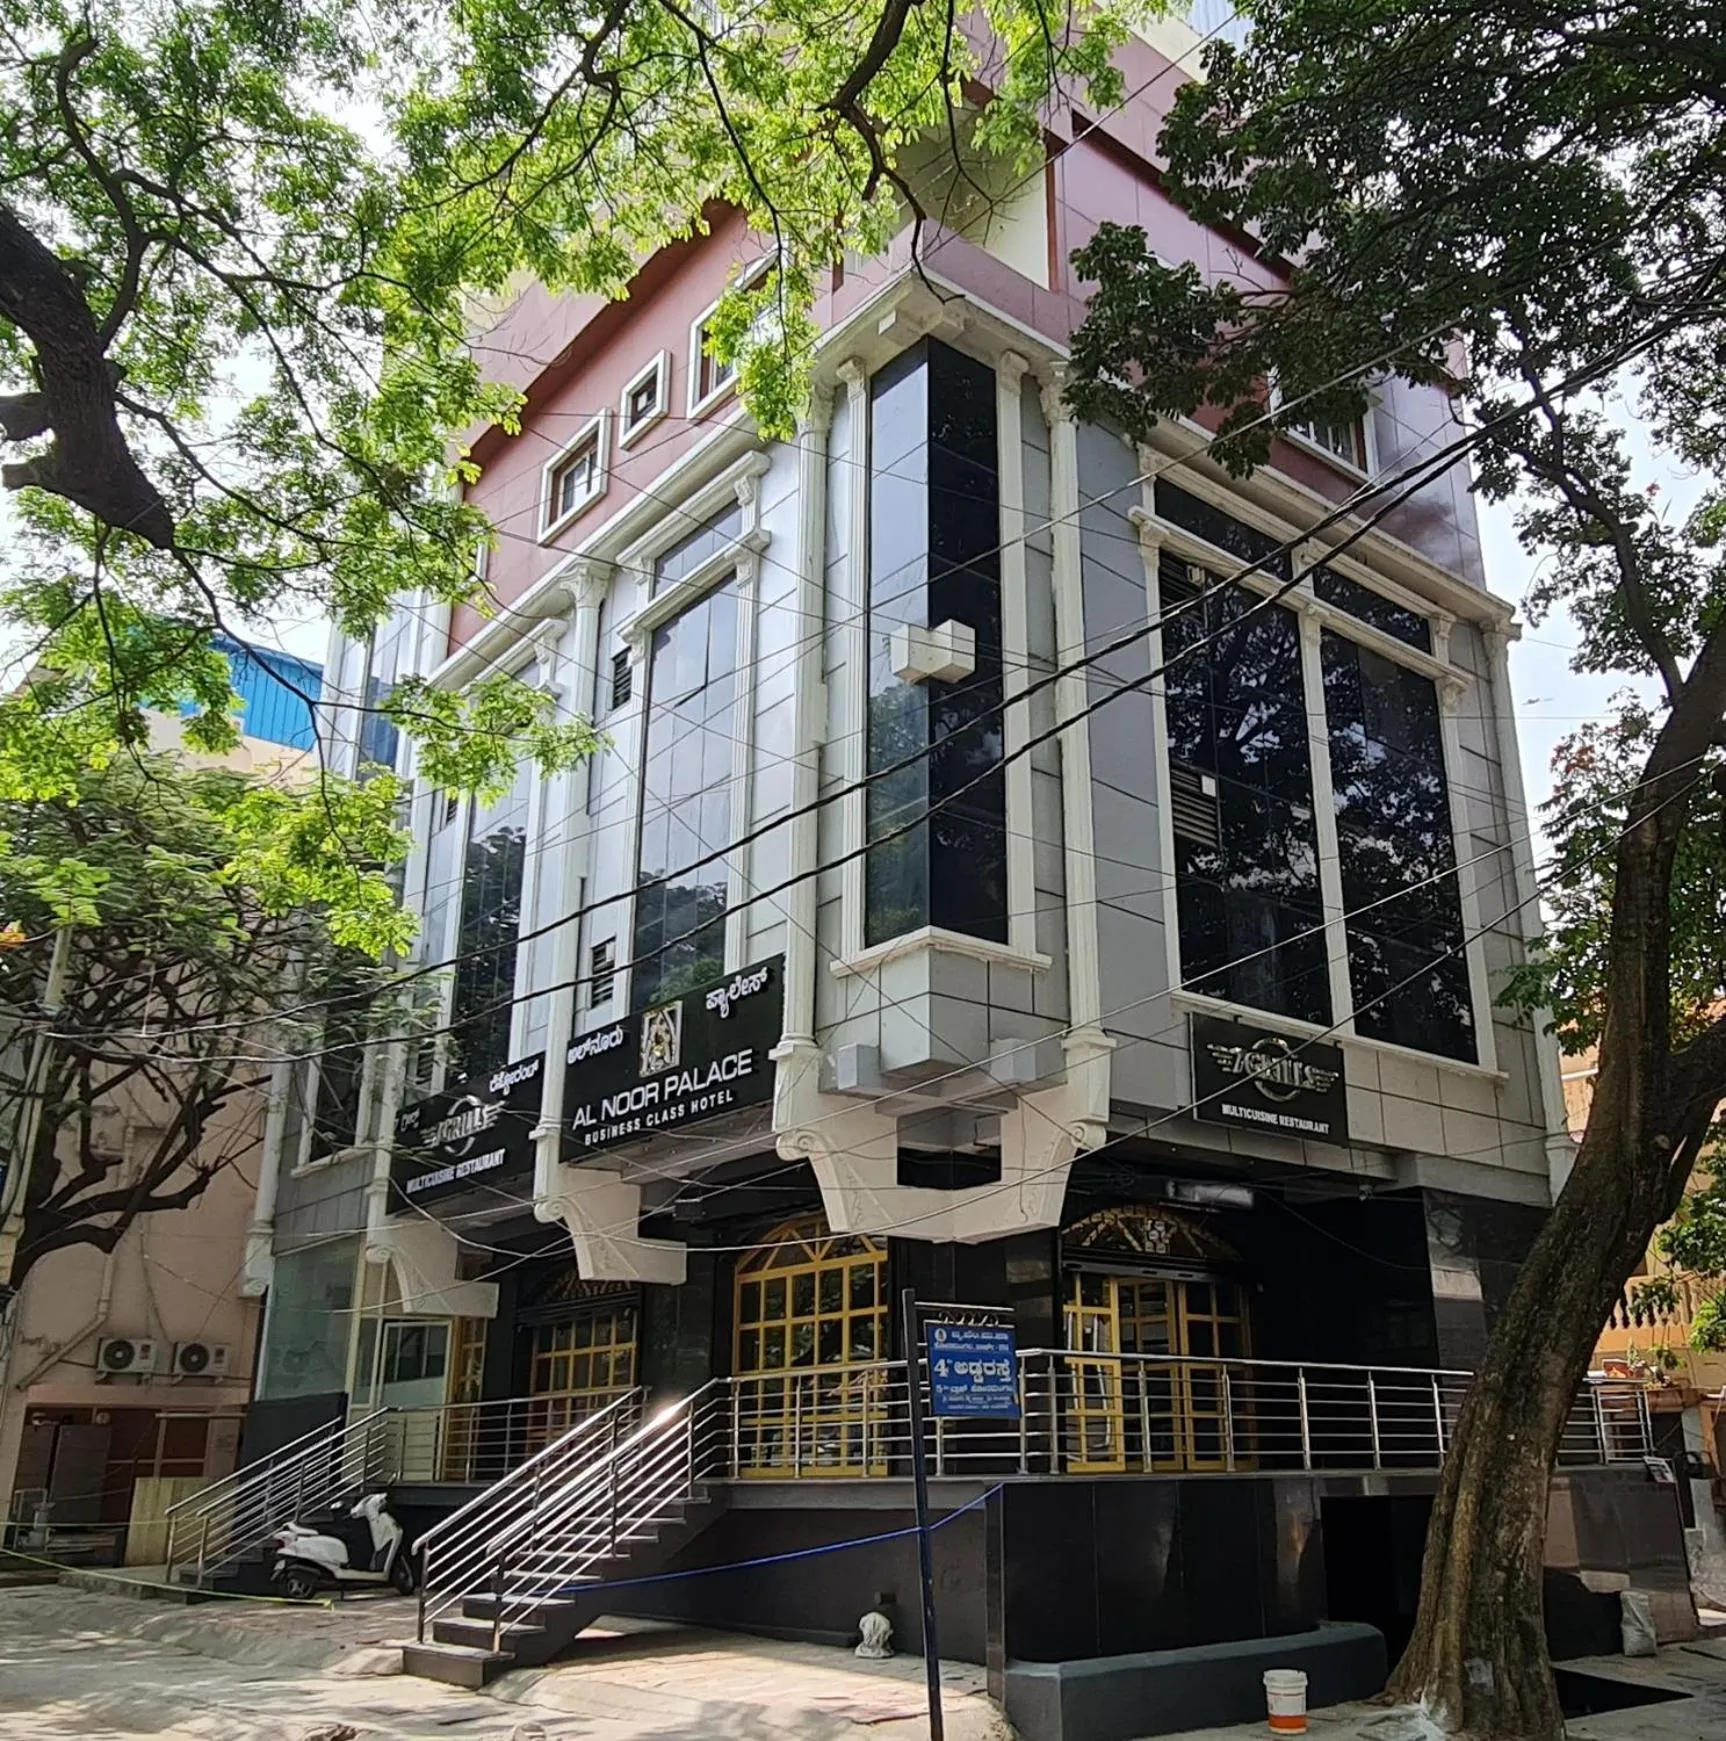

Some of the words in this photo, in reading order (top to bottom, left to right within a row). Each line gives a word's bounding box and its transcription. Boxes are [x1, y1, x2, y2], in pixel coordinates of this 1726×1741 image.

[572, 1105, 597, 1131] AL
[601, 1082, 659, 1121] NOOR
[664, 1049, 753, 1101] PALACE
[585, 1117, 641, 1146] BUSINESS
[646, 1106, 685, 1127] CLASS
[691, 1089, 733, 1114] HOTEL
[1221, 1103, 1278, 1124] MULTICUISINE
[1279, 1115, 1329, 1134] RESTAURANT
[406, 1166, 454, 1194] MULTICUISINE
[456, 1148, 506, 1179] RESTAURANT
